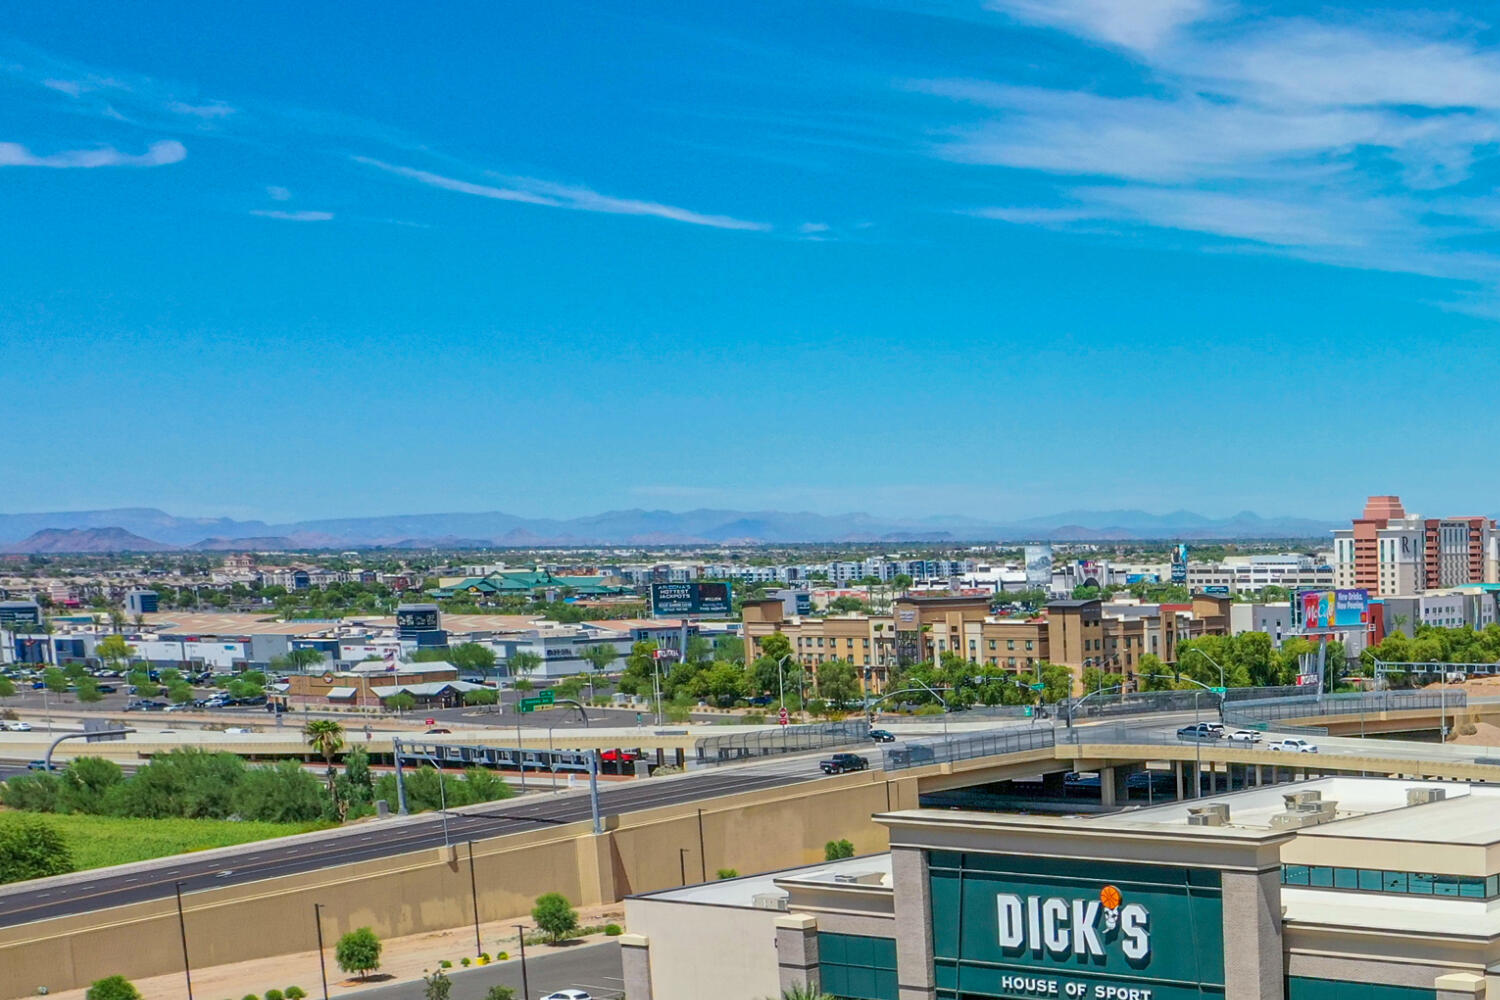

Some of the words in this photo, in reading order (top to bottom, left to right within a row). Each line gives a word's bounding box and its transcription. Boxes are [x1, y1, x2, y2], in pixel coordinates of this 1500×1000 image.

[1402, 536, 1410, 553] R
[997, 889, 1150, 959] DICK'S
[1002, 976, 1058, 994] HOUSE
[1065, 982, 1087, 996] OF
